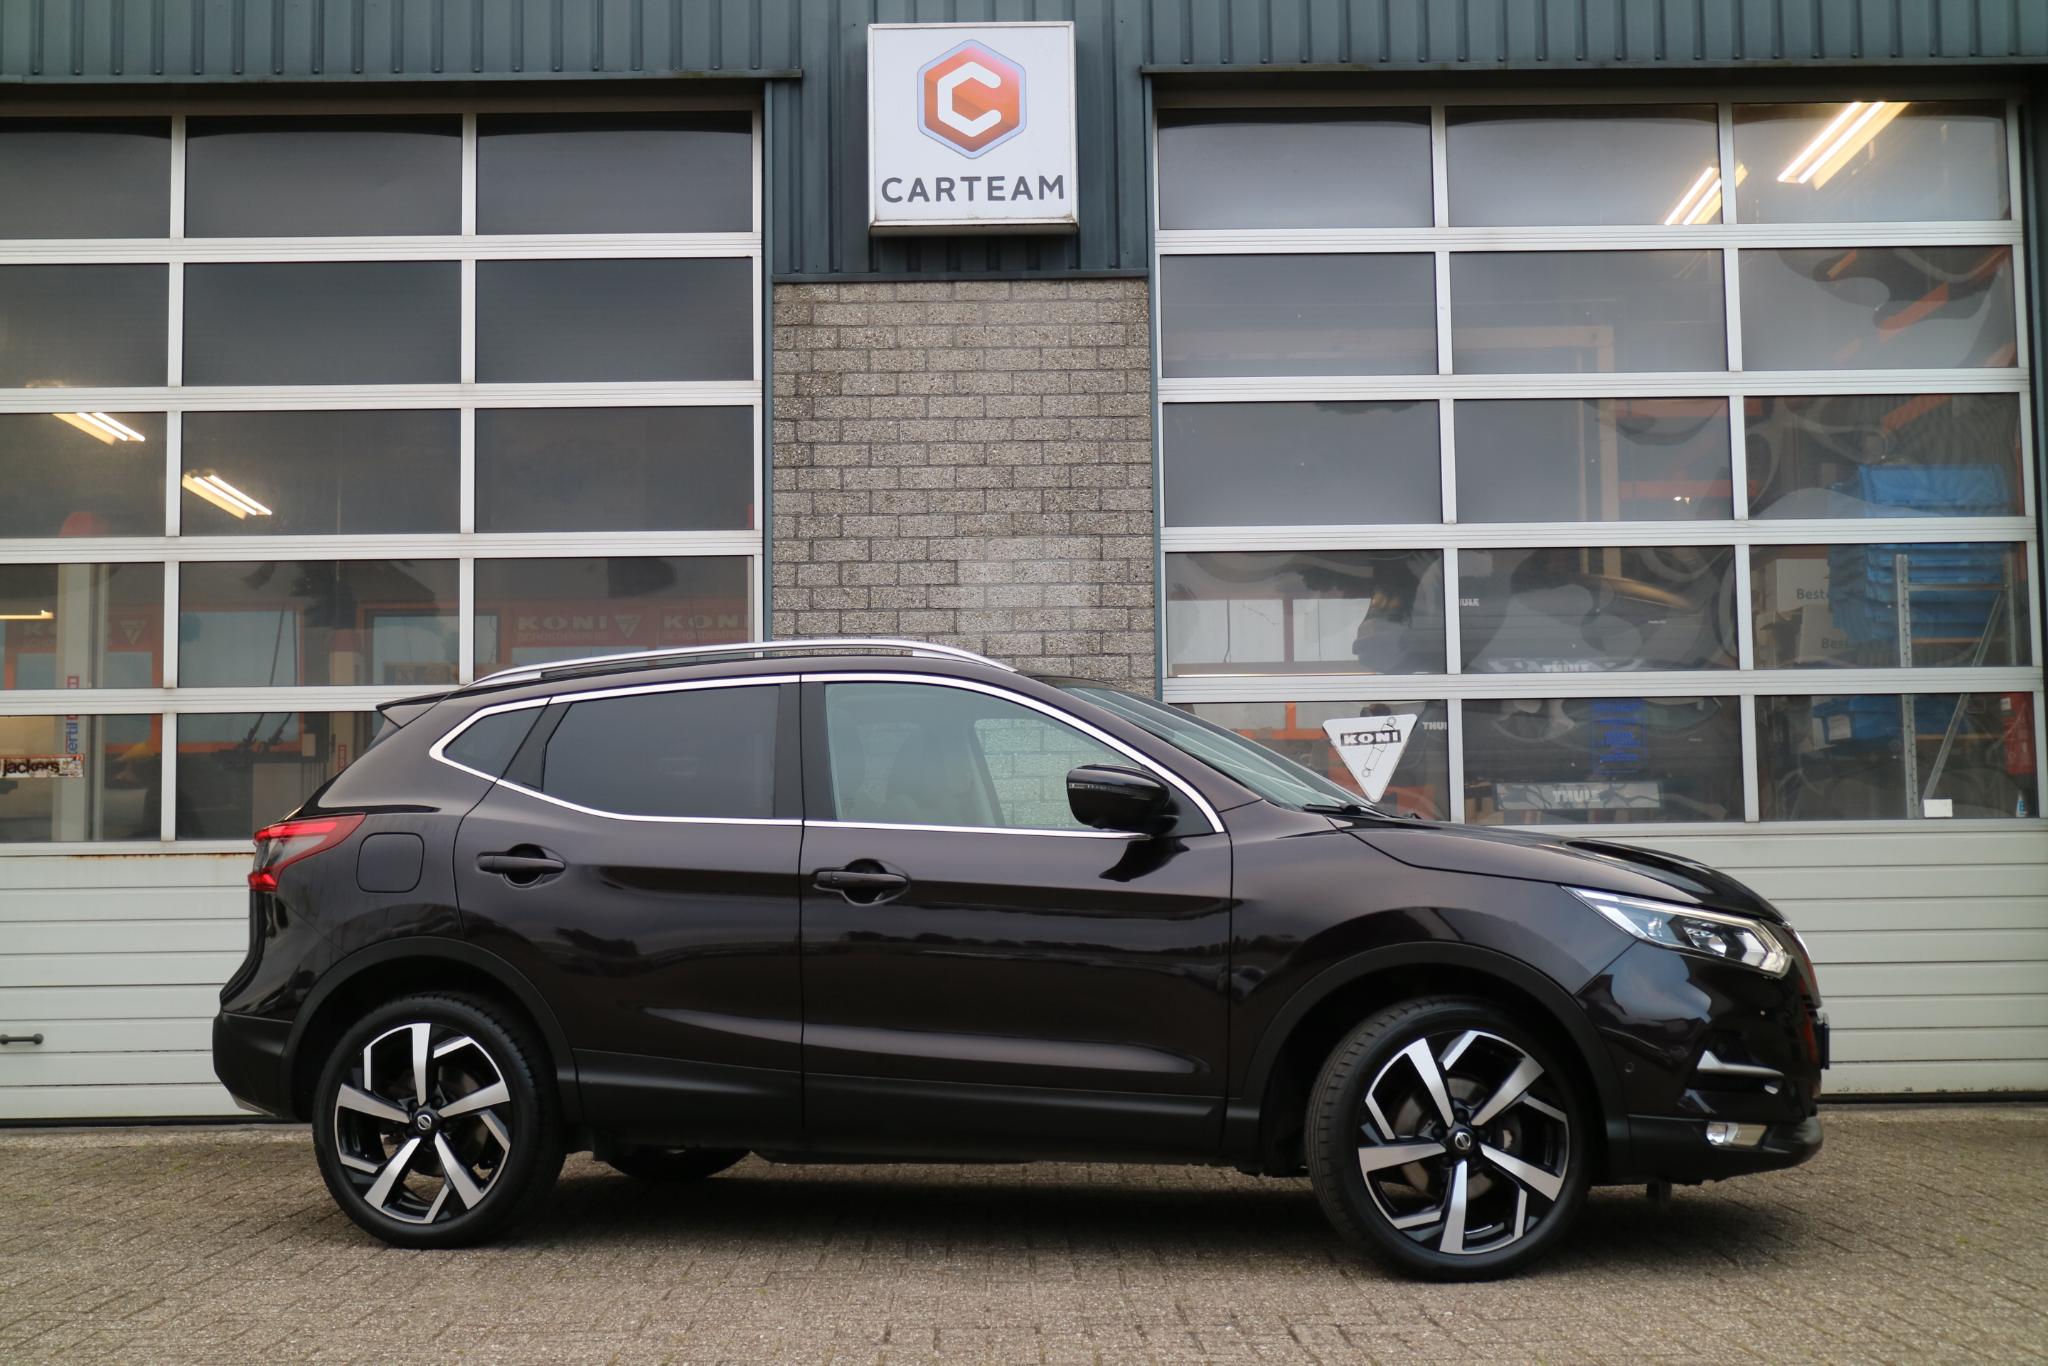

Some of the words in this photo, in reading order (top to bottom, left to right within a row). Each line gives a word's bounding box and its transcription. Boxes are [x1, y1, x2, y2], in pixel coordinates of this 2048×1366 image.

[880, 174, 1065, 203] CARTEAM
[1459, 598, 1480, 607] ULE
[517, 615, 608, 631] KONI
[1422, 721, 1447, 730] THU
[1343, 731, 1399, 745] KONI
[1552, 790, 1601, 803] THULE
